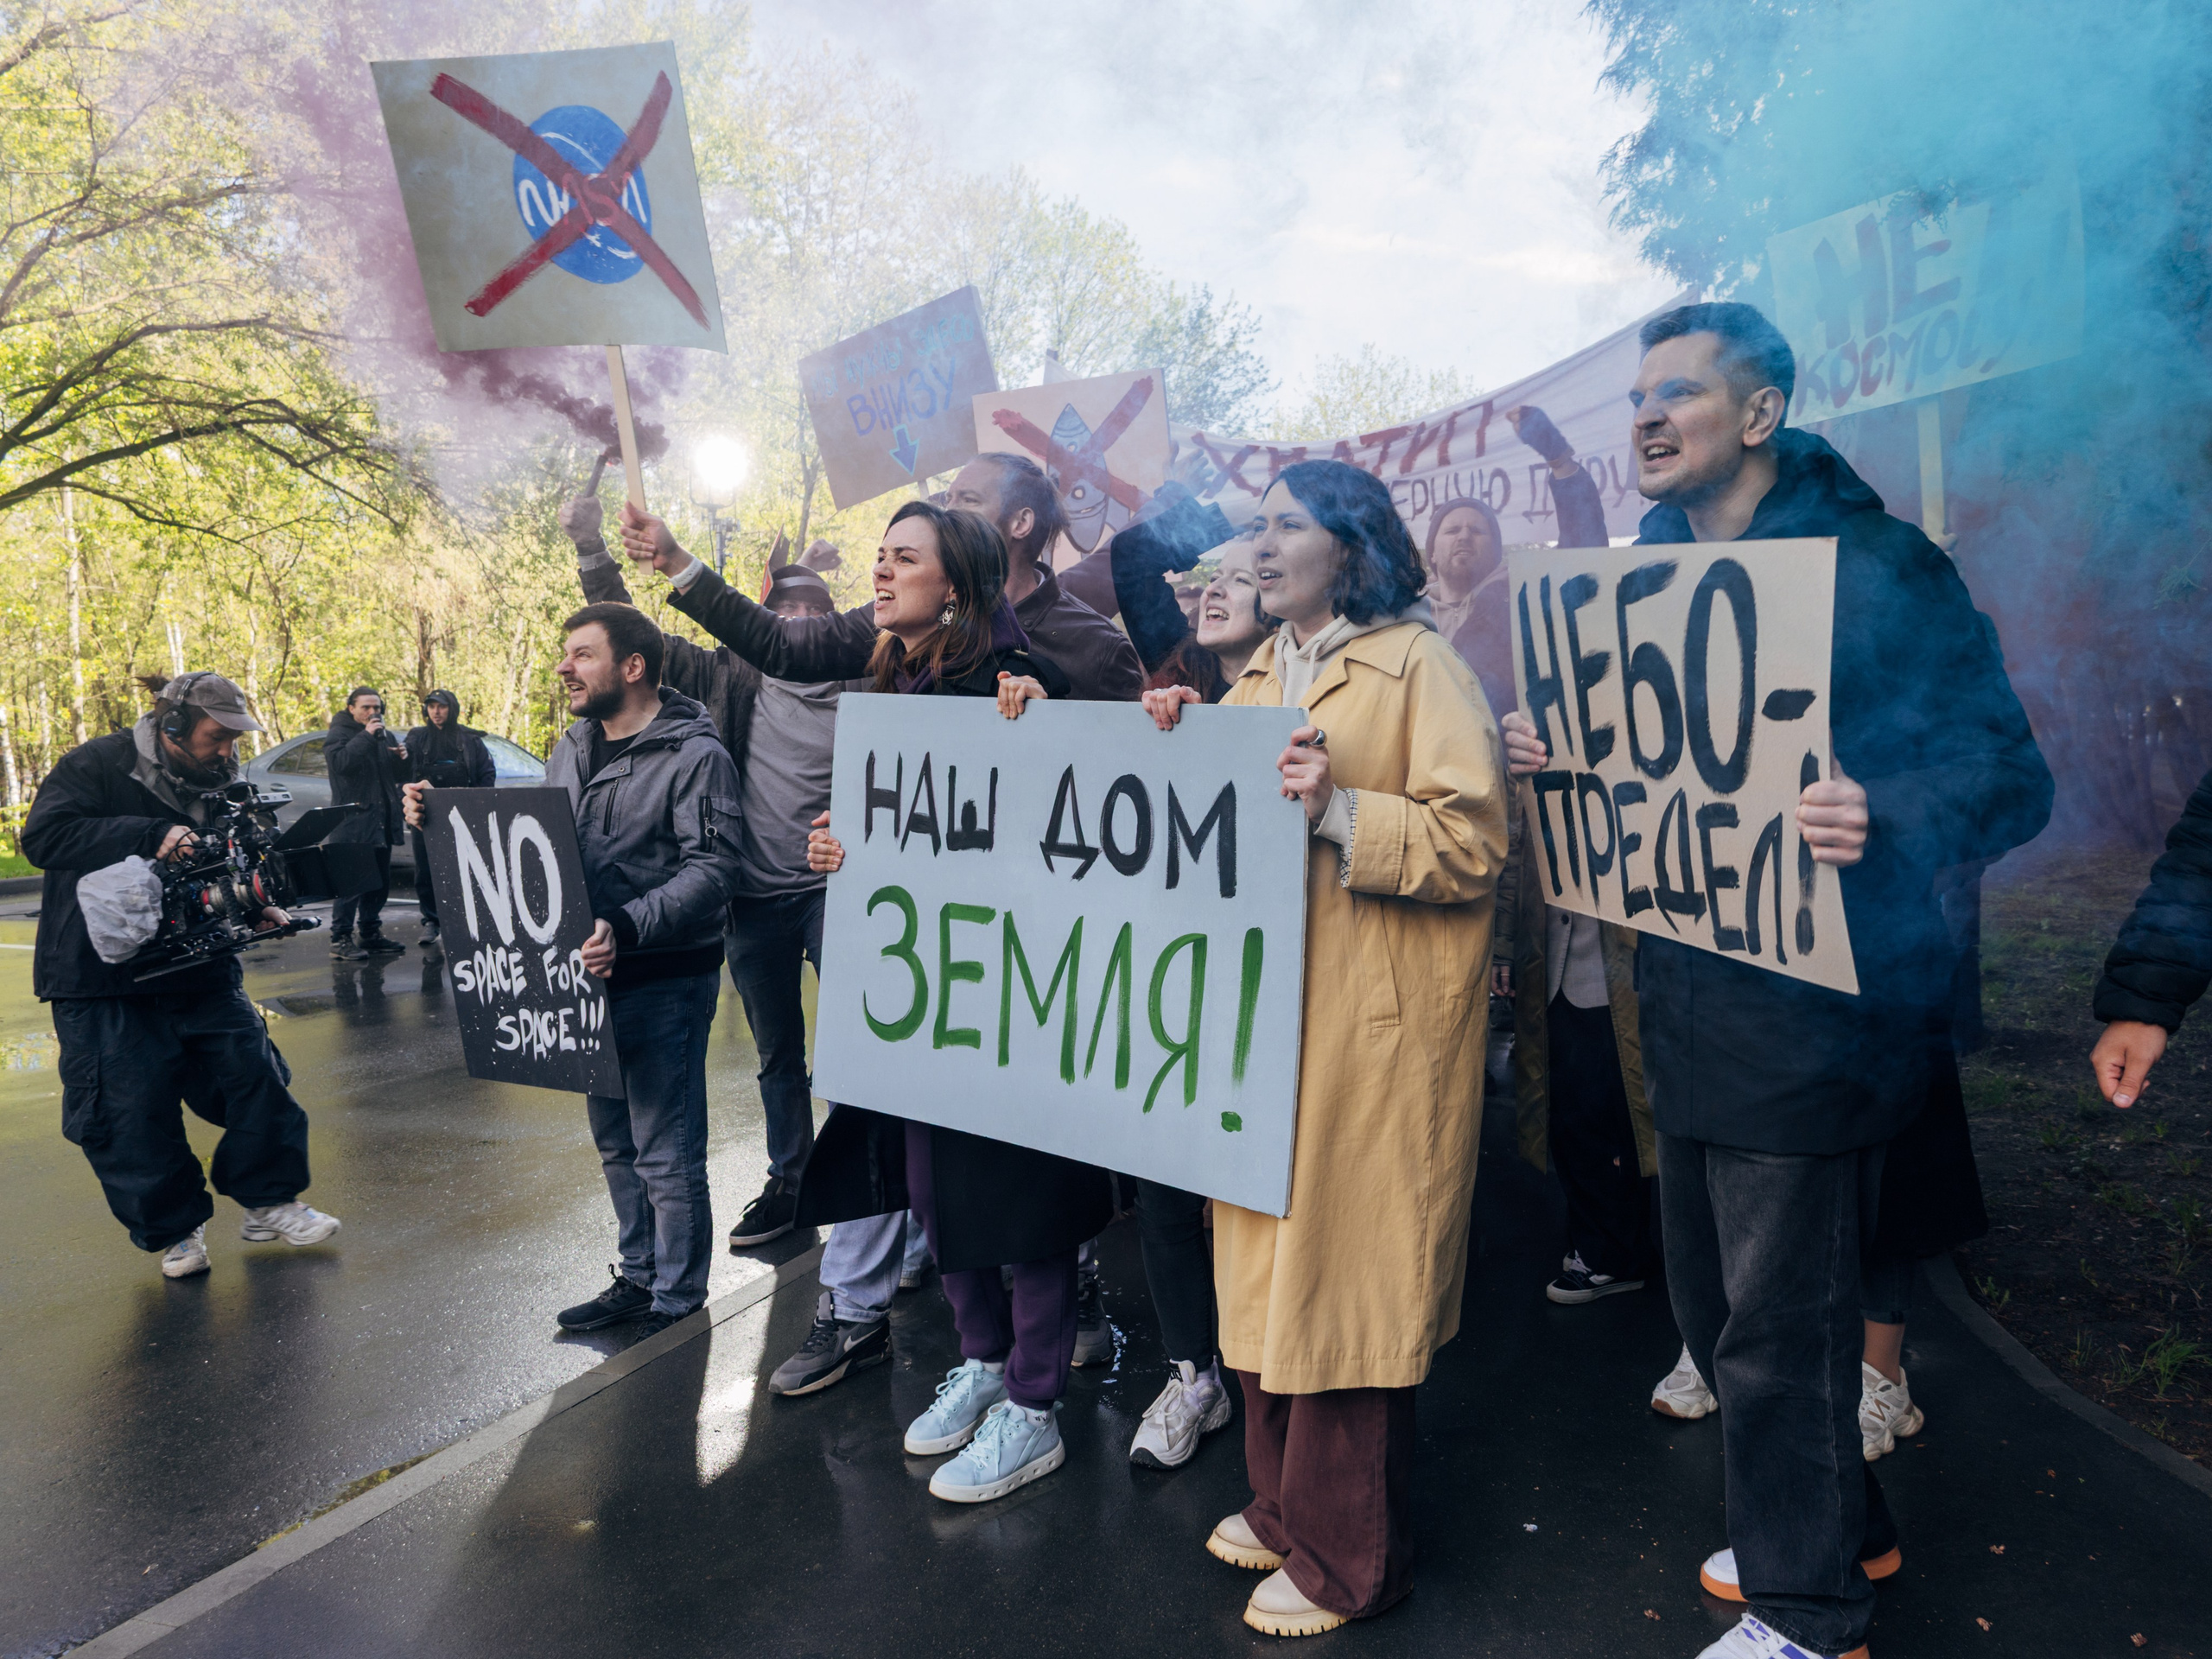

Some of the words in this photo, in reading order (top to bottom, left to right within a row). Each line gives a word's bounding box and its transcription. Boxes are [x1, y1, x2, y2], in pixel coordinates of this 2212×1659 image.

[846, 355, 957, 437] ВНИЗУ
[448, 805, 563, 947] NO
[864, 749, 998, 857] НАШ
[1039, 763, 1237, 899] ДОМ
[454, 944, 527, 1007] SPACE
[495, 995, 605, 1062] SPACE!!!
[863, 884, 1264, 1133] ЗЕМЛЯ!
